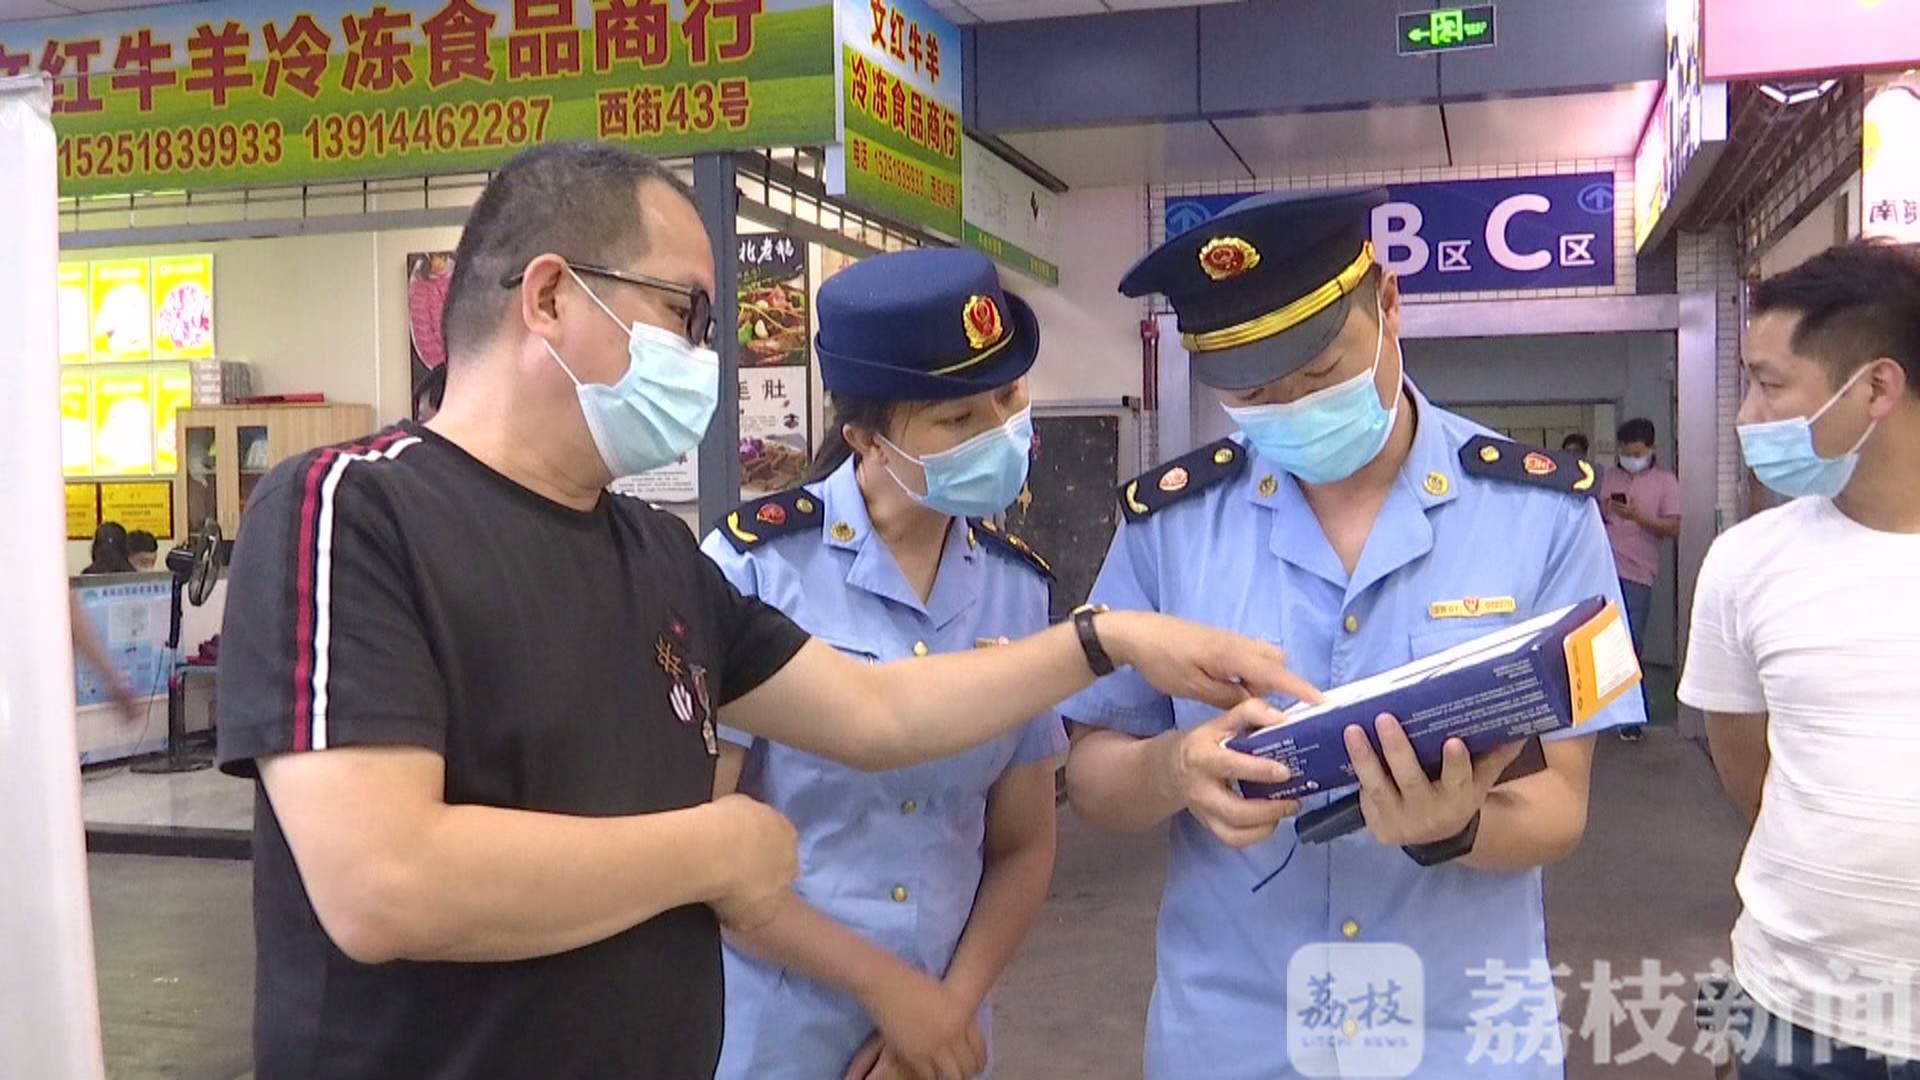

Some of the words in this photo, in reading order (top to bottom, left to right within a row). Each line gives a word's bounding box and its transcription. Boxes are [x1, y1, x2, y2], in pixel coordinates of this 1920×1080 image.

[0, 0, 763, 113] 红牛羊冷冻食品商行
[870, 0, 940, 83] 文红牛羊
[58, 119, 284, 178] 15251839933
[304, 97, 551, 160] 13914462287
[600, 80, 750, 138] 西街43号
[851, 54, 957, 159] 冷冻食品商行
[1371, 202, 1472, 276] B区
[1485, 193, 1596, 271] C区
